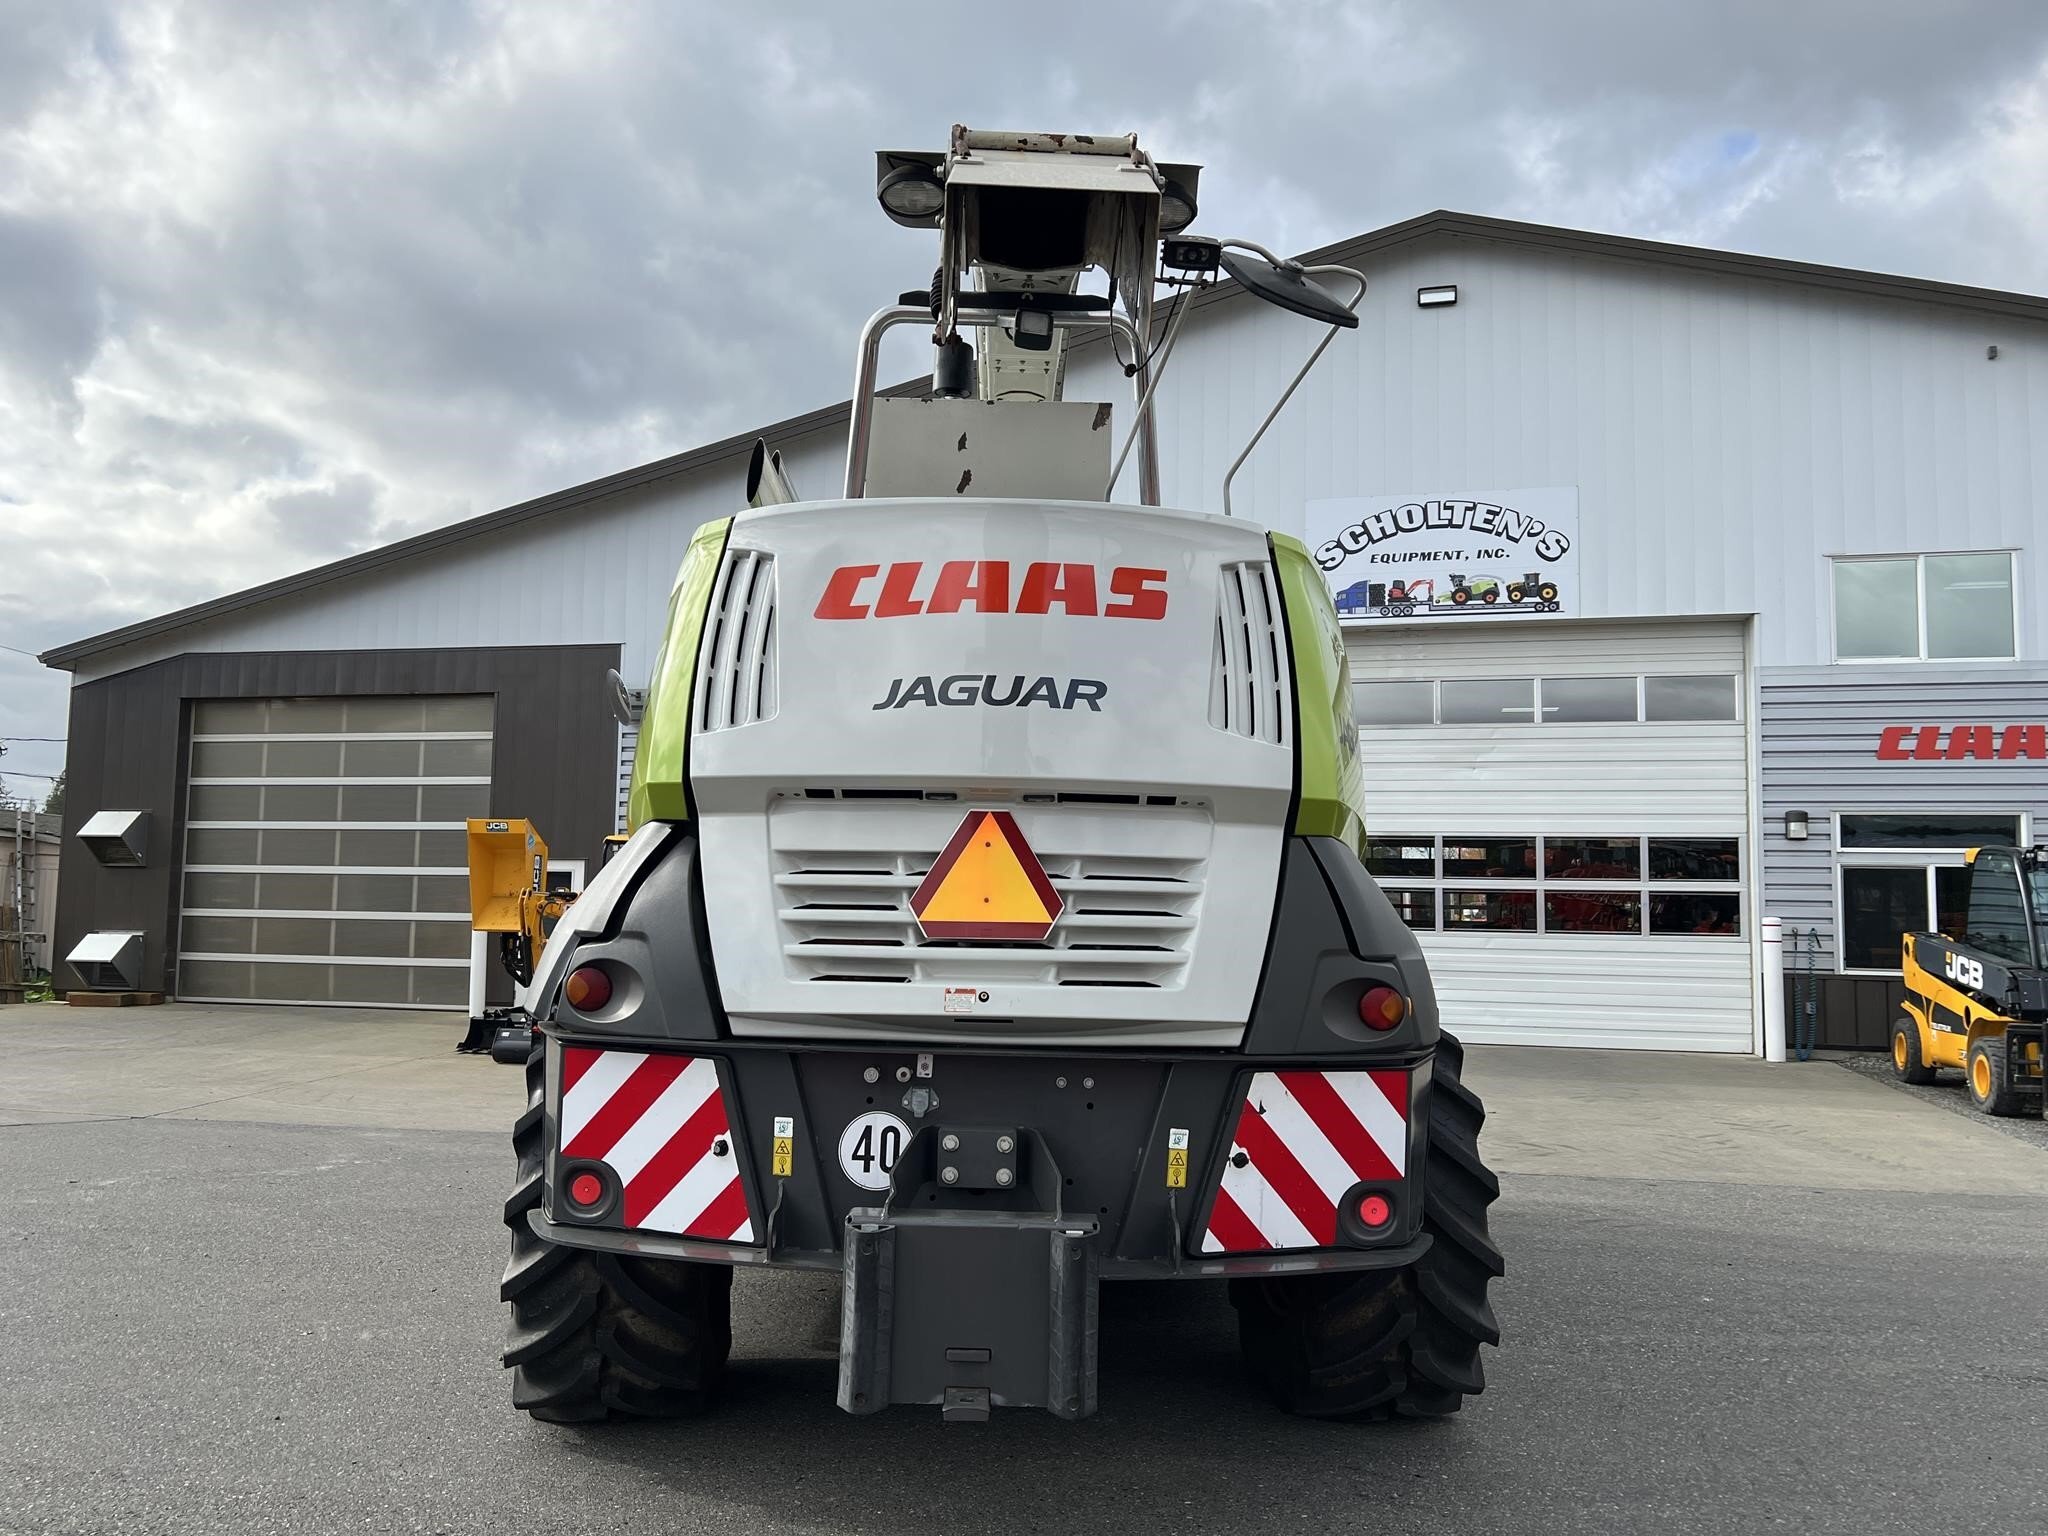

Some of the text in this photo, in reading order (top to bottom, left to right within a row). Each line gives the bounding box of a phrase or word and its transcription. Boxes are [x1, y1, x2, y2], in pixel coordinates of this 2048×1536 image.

[1314, 500, 1571, 571] SCHOLTEN'S
[1370, 548, 1511, 564] EQUIPMENT, INC.
[813, 560, 1168, 620] CLAAS
[872, 674, 1108, 712] JAGUAR
[486, 822, 508, 830] JCB
[1945, 951, 1984, 990] JCB
[851, 1125, 901, 1174] 40
